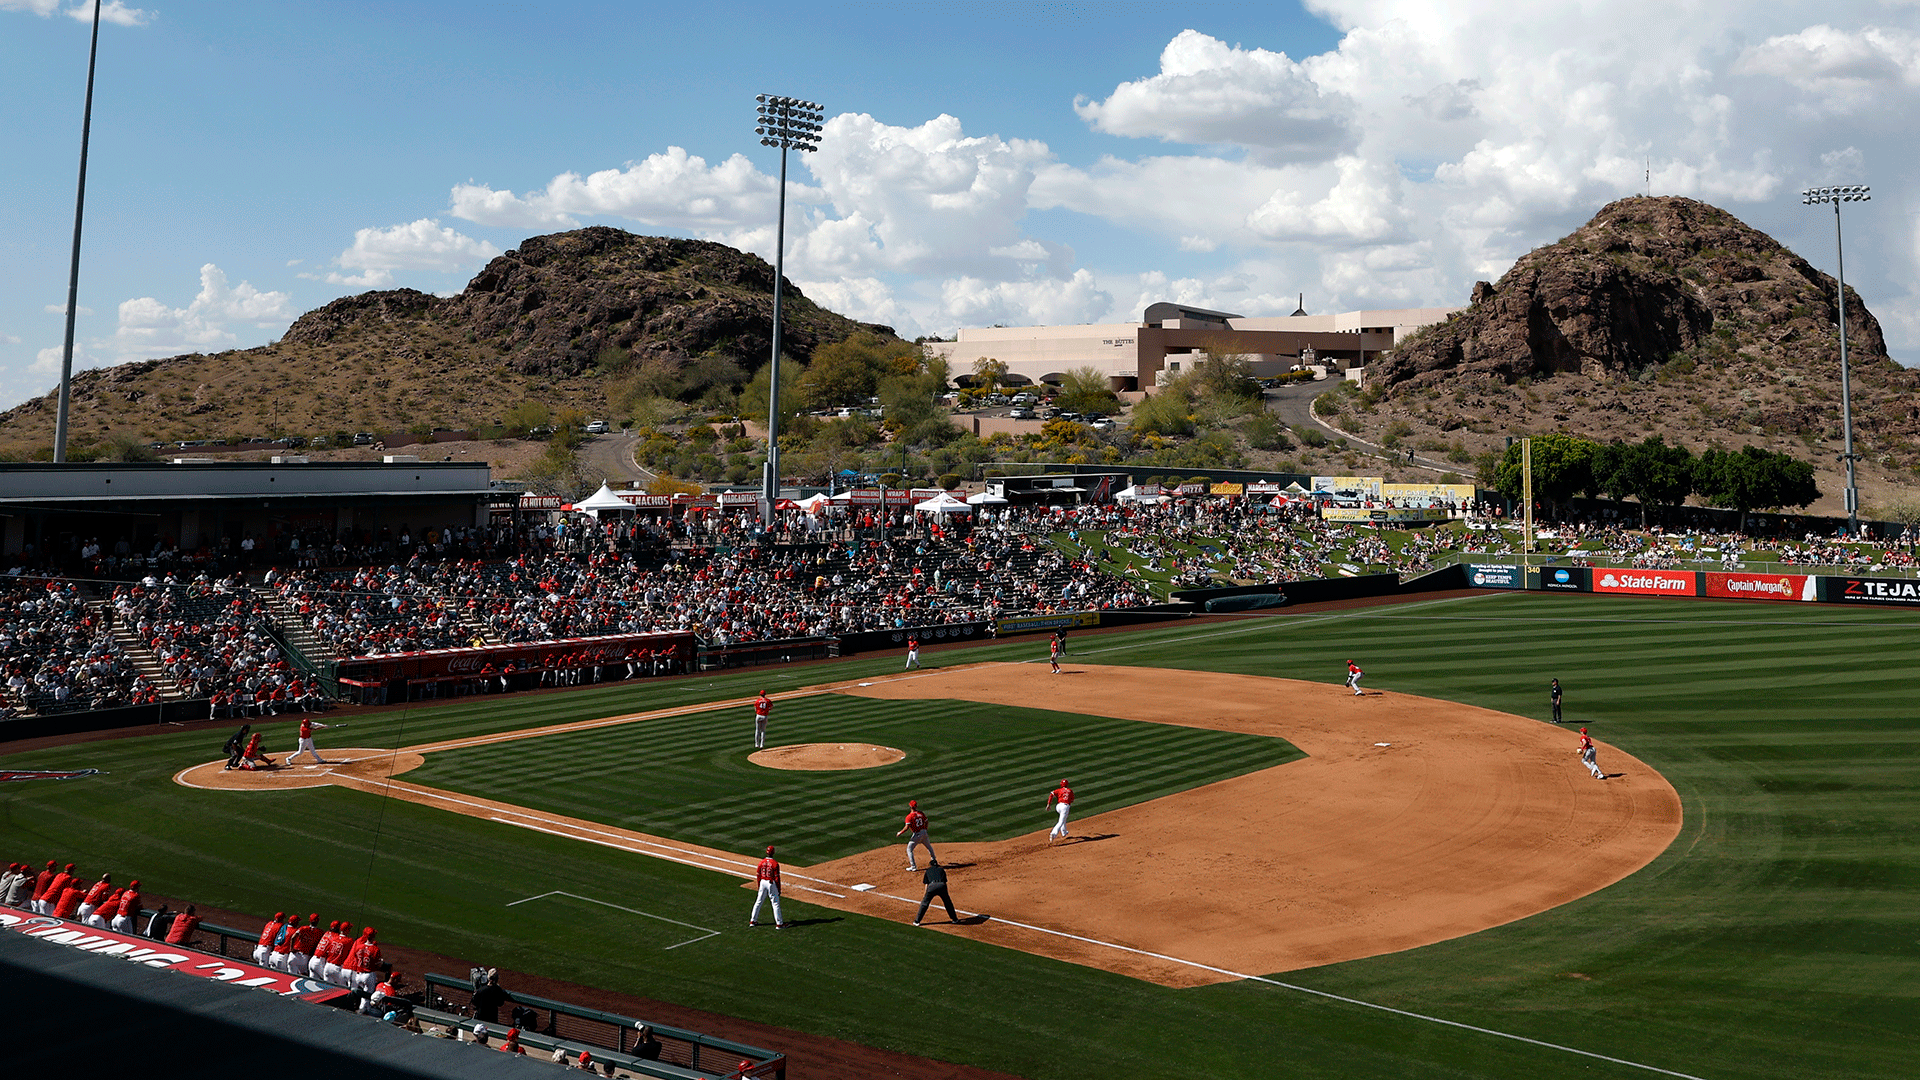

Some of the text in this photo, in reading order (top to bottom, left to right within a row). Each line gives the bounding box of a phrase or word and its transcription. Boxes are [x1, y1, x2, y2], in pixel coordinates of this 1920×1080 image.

[1182, 486, 1204, 494] PIZZA
[1247, 483, 1280, 492] MARGARITAS
[528, 498, 542, 508] HOT
[542, 497, 560, 508] DOGS
[635, 495, 670, 506] NACHOS
[723, 493, 756, 504] MARGARITAS
[1527, 566, 1541, 574] 340
[1727, 579, 1783, 594] Captain Morgan
[1844, 580, 1920, 597] Z TEJA
[915, 817, 924, 827] 23
